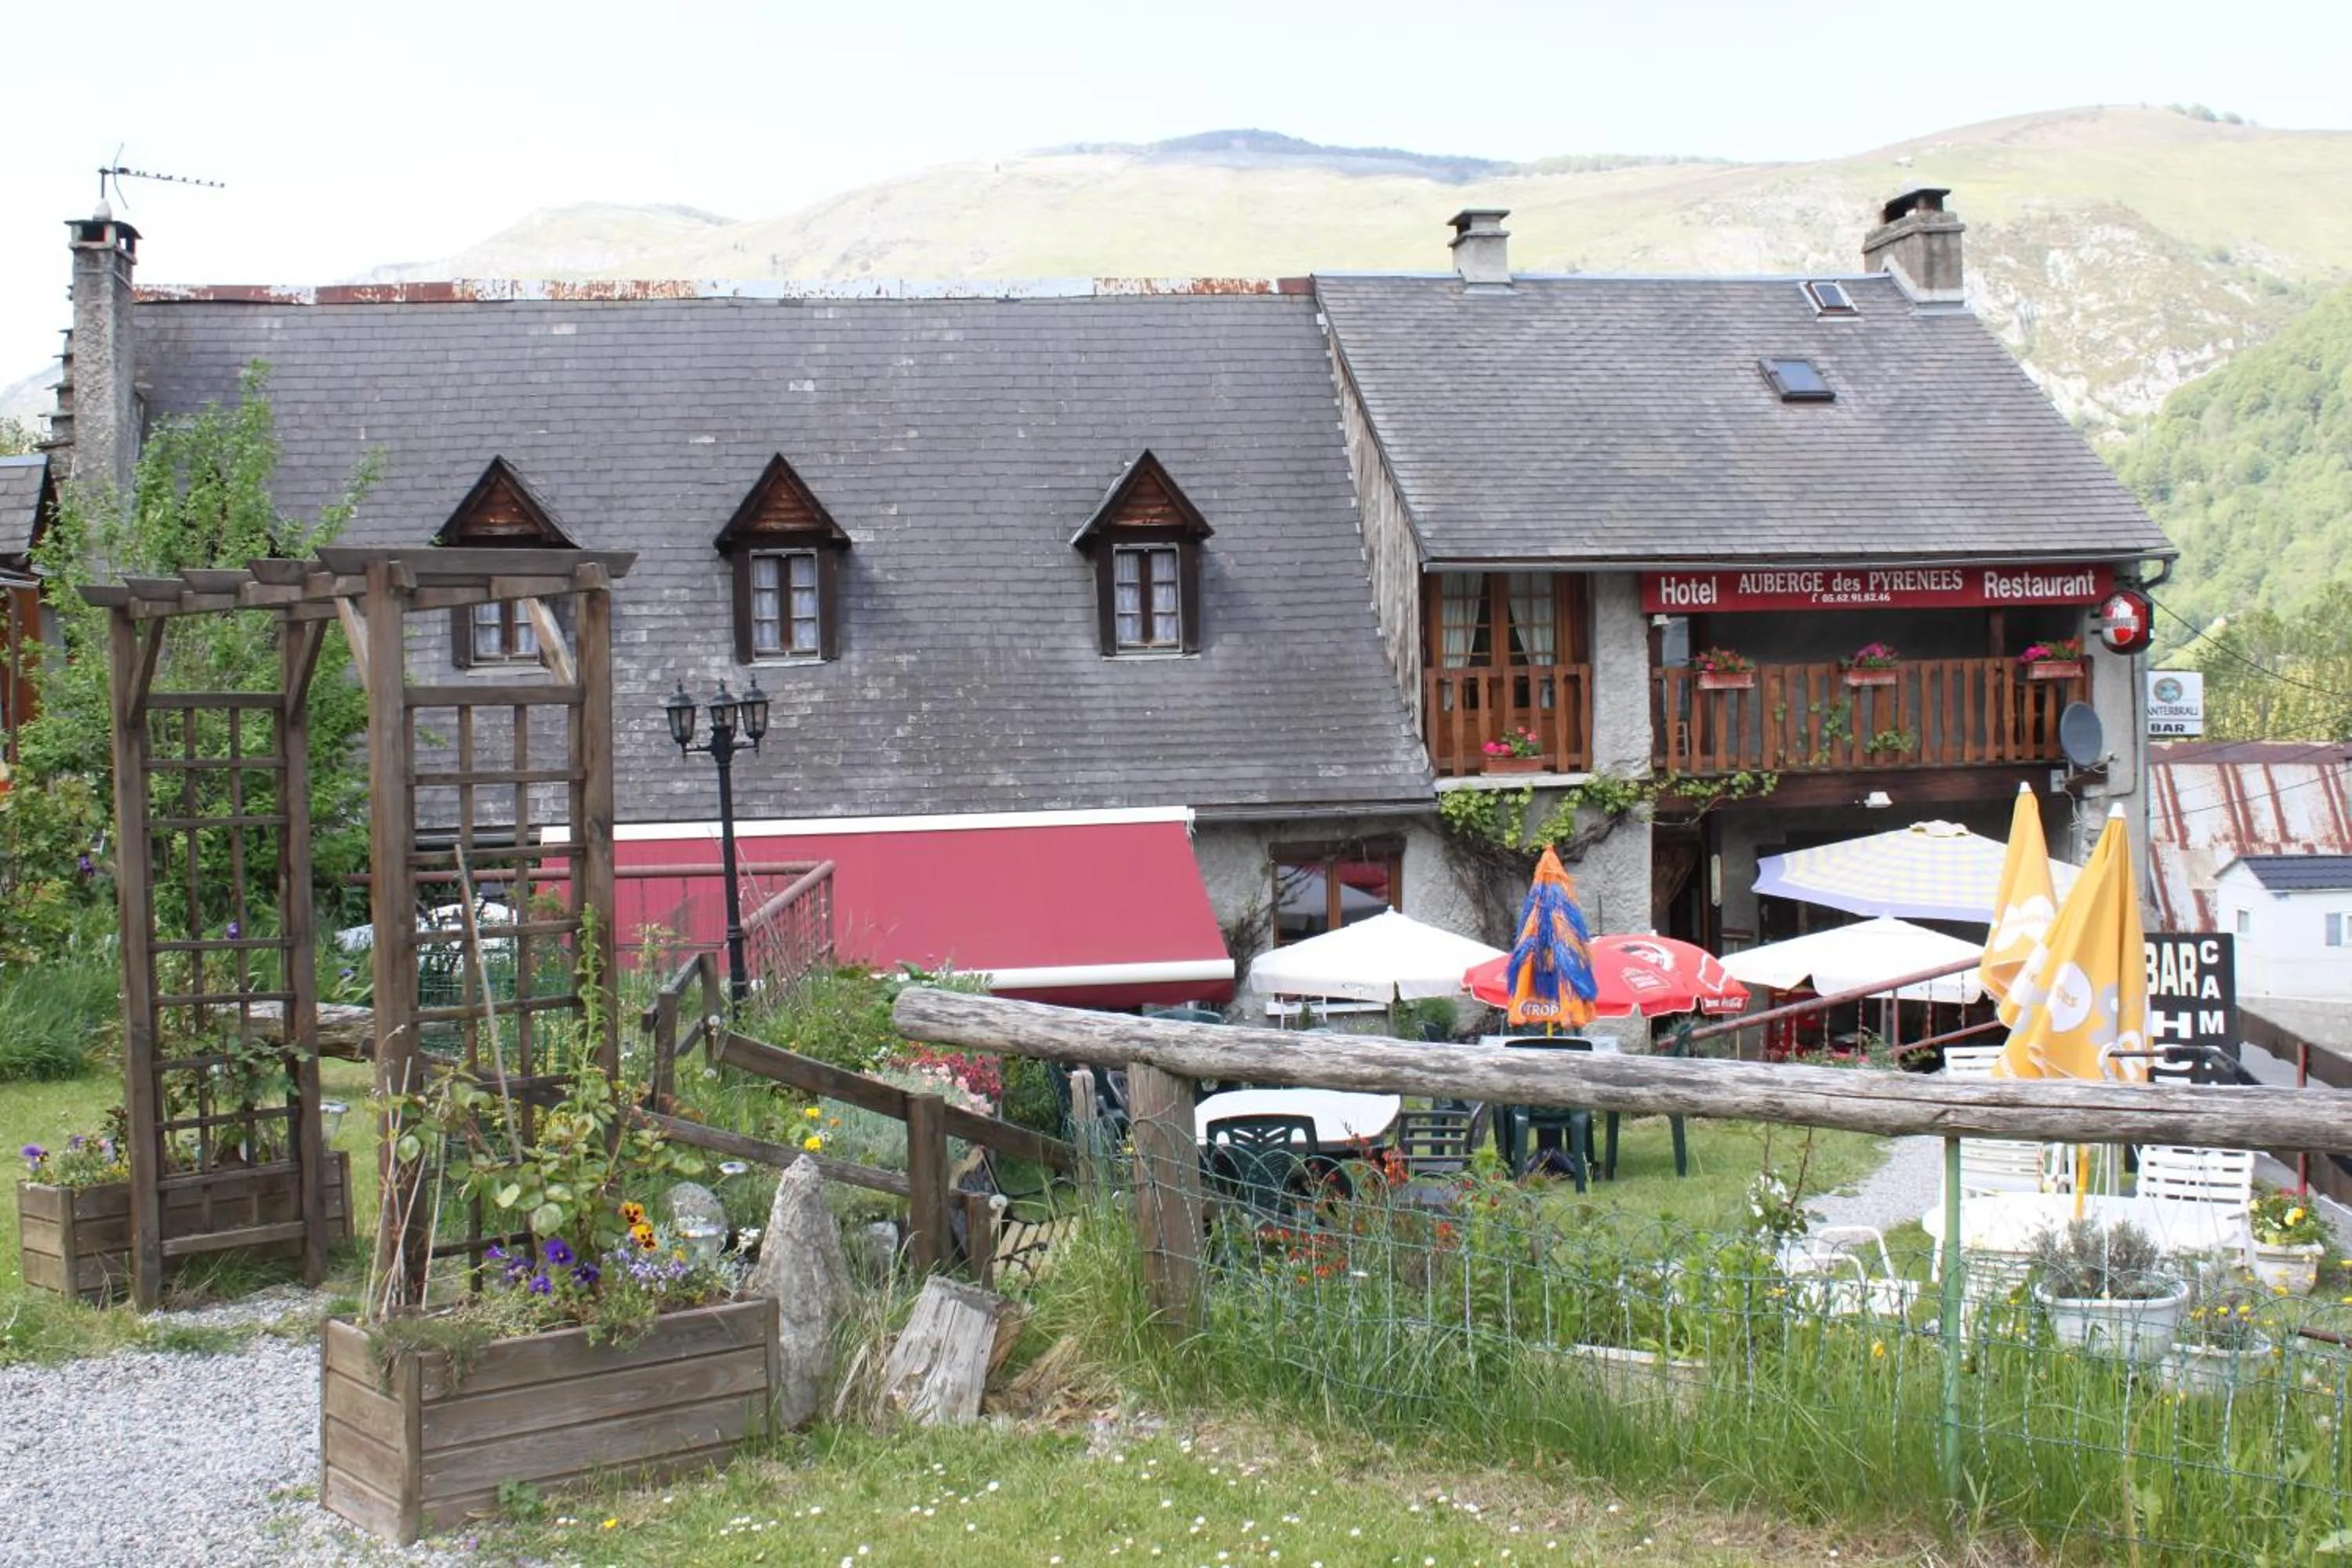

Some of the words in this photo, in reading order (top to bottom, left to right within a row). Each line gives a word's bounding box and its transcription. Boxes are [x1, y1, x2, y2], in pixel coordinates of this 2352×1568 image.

[1660, 575, 1718, 604] Hotel
[1738, 572, 1824, 593] AUBERGE
[1832, 572, 1861, 592] des
[1869, 570, 1963, 590] PYRENEES
[1984, 570, 2096, 598] Restaurant
[2151, 724, 2185, 732] BAR
[2144, 942, 2198, 996] BAR
